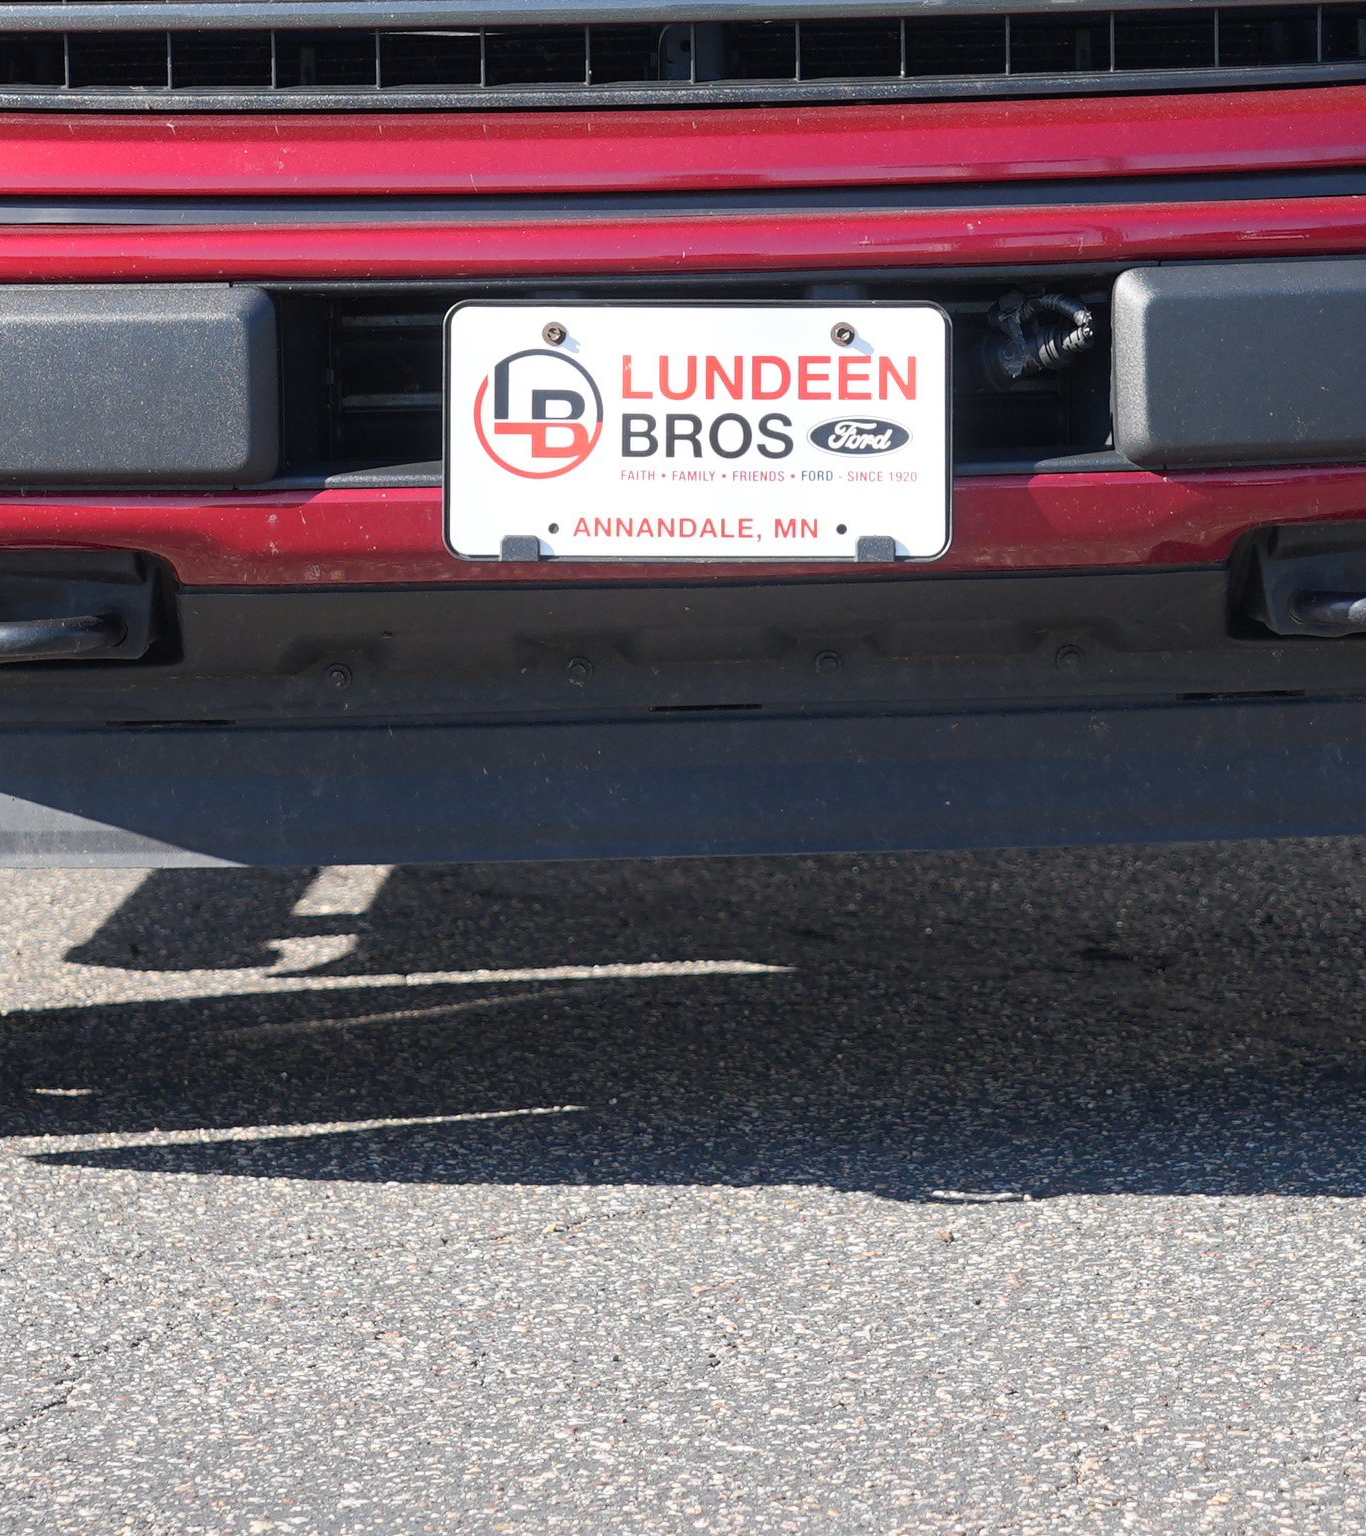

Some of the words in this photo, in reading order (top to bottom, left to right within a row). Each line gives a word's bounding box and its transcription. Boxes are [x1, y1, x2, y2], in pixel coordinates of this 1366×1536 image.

[621, 354, 917, 401] LUNDEEN
[621, 412, 794, 459] BROS
[827, 418, 893, 452] Ford
[620, 470, 655, 481] FAITH
[672, 470, 716, 482] FAMILY
[732, 470, 785, 482] FRIENDS
[801, 470, 834, 482] FORD
[847, 470, 884, 482] SINCE
[889, 471, 918, 482] 1920
[573, 517, 763, 542] ANNANDALE,
[774, 518, 819, 539] MN
